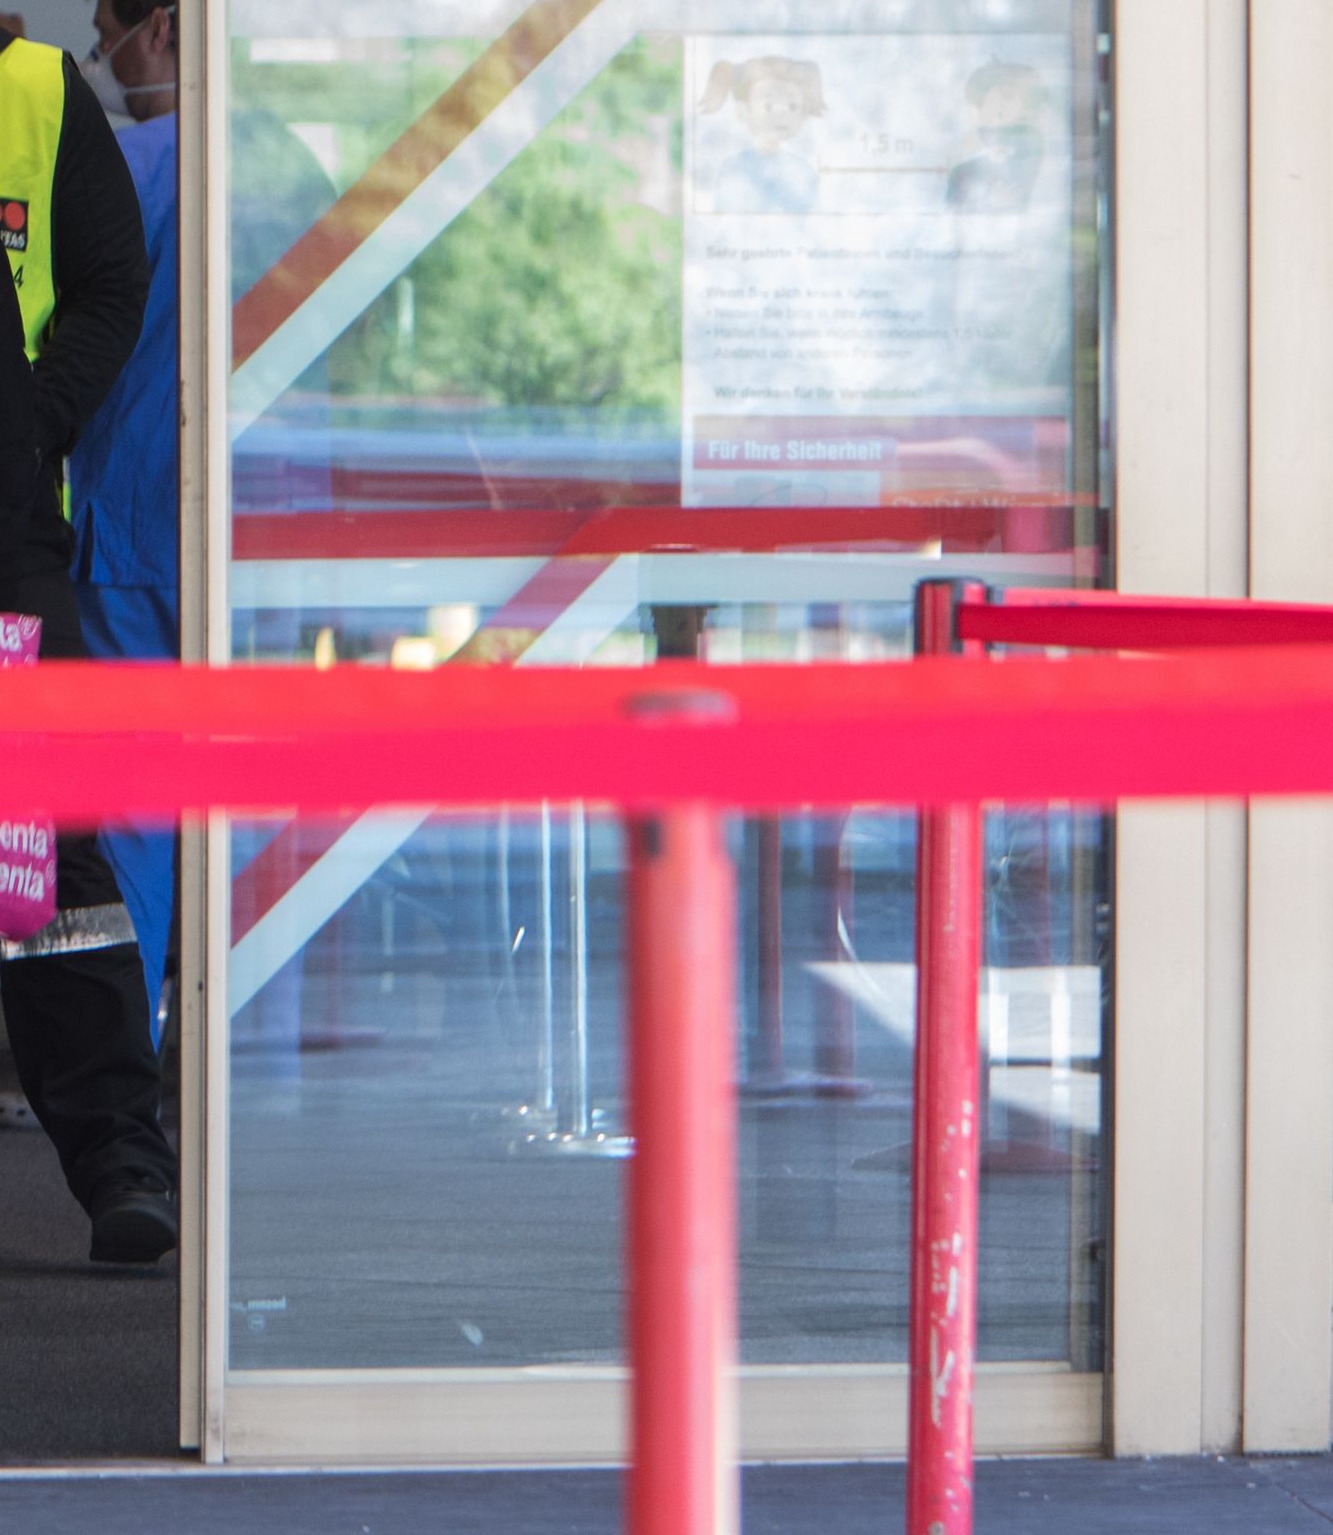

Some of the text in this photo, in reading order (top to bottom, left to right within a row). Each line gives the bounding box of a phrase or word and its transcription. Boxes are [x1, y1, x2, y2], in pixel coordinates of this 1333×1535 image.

[707, 439, 883, 461] Für Ihre Sicherheit
